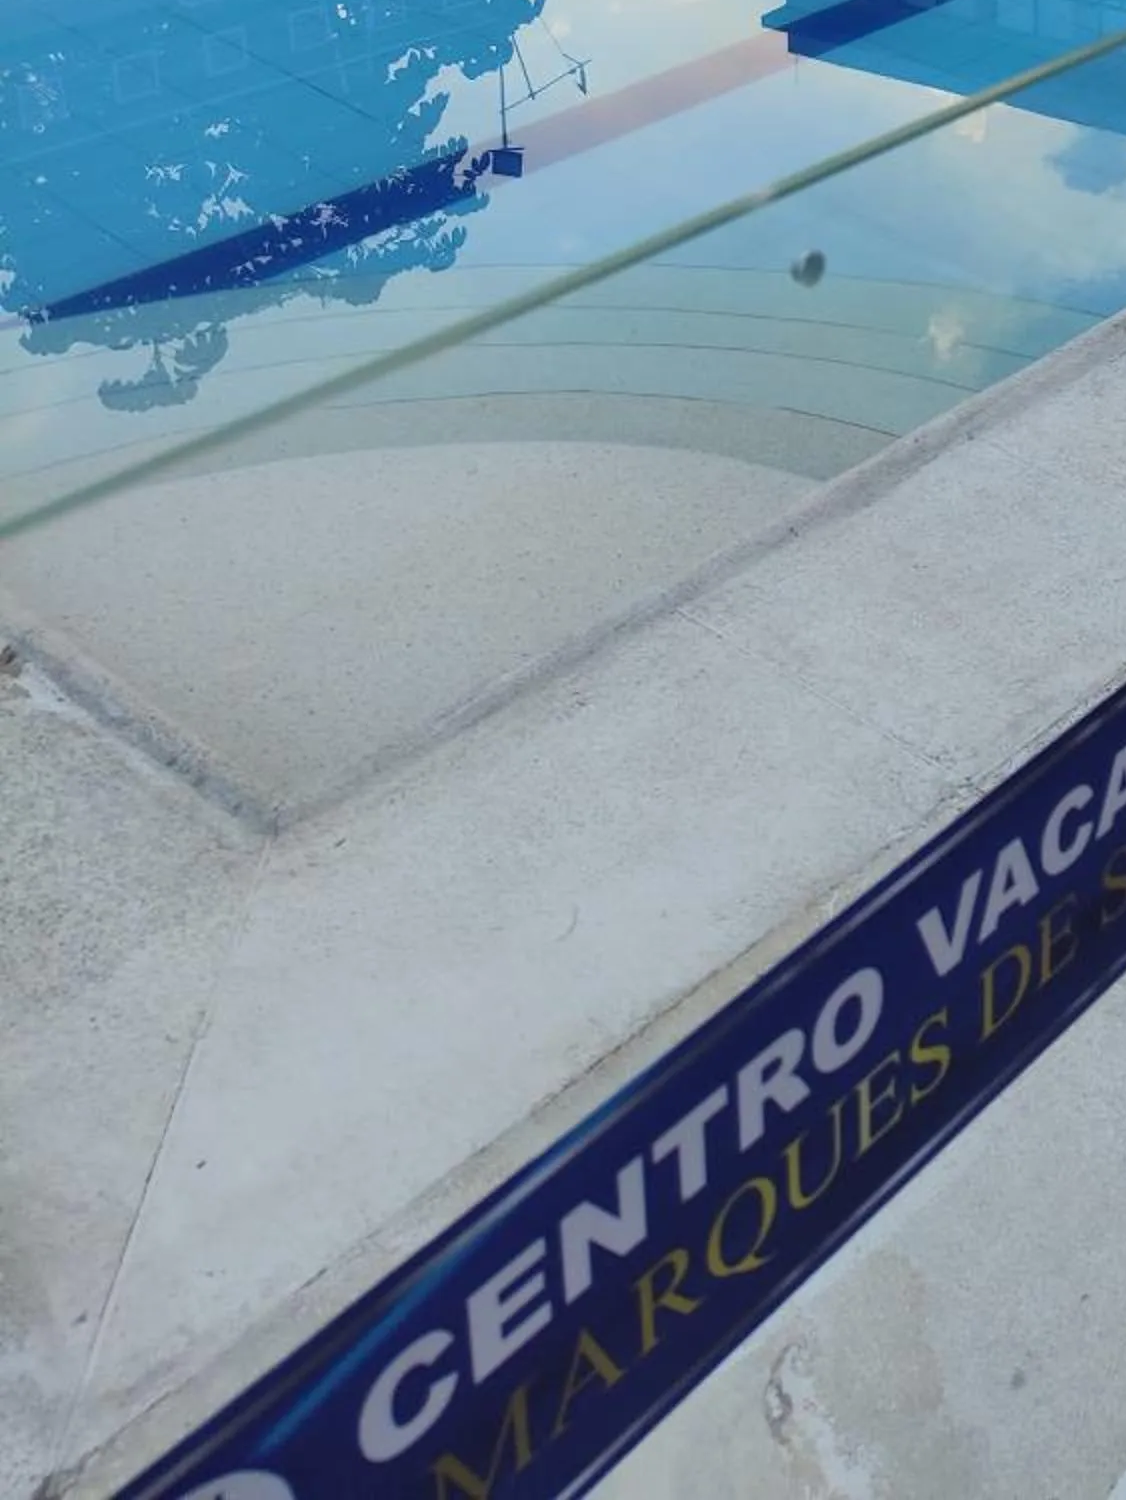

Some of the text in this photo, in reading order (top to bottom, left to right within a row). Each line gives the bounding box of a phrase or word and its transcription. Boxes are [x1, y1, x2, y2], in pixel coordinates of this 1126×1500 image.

[357, 966, 885, 1463] CENTRO
[428, 1007, 953, 1500] MARQUES
[977, 890, 1081, 1045] DE
